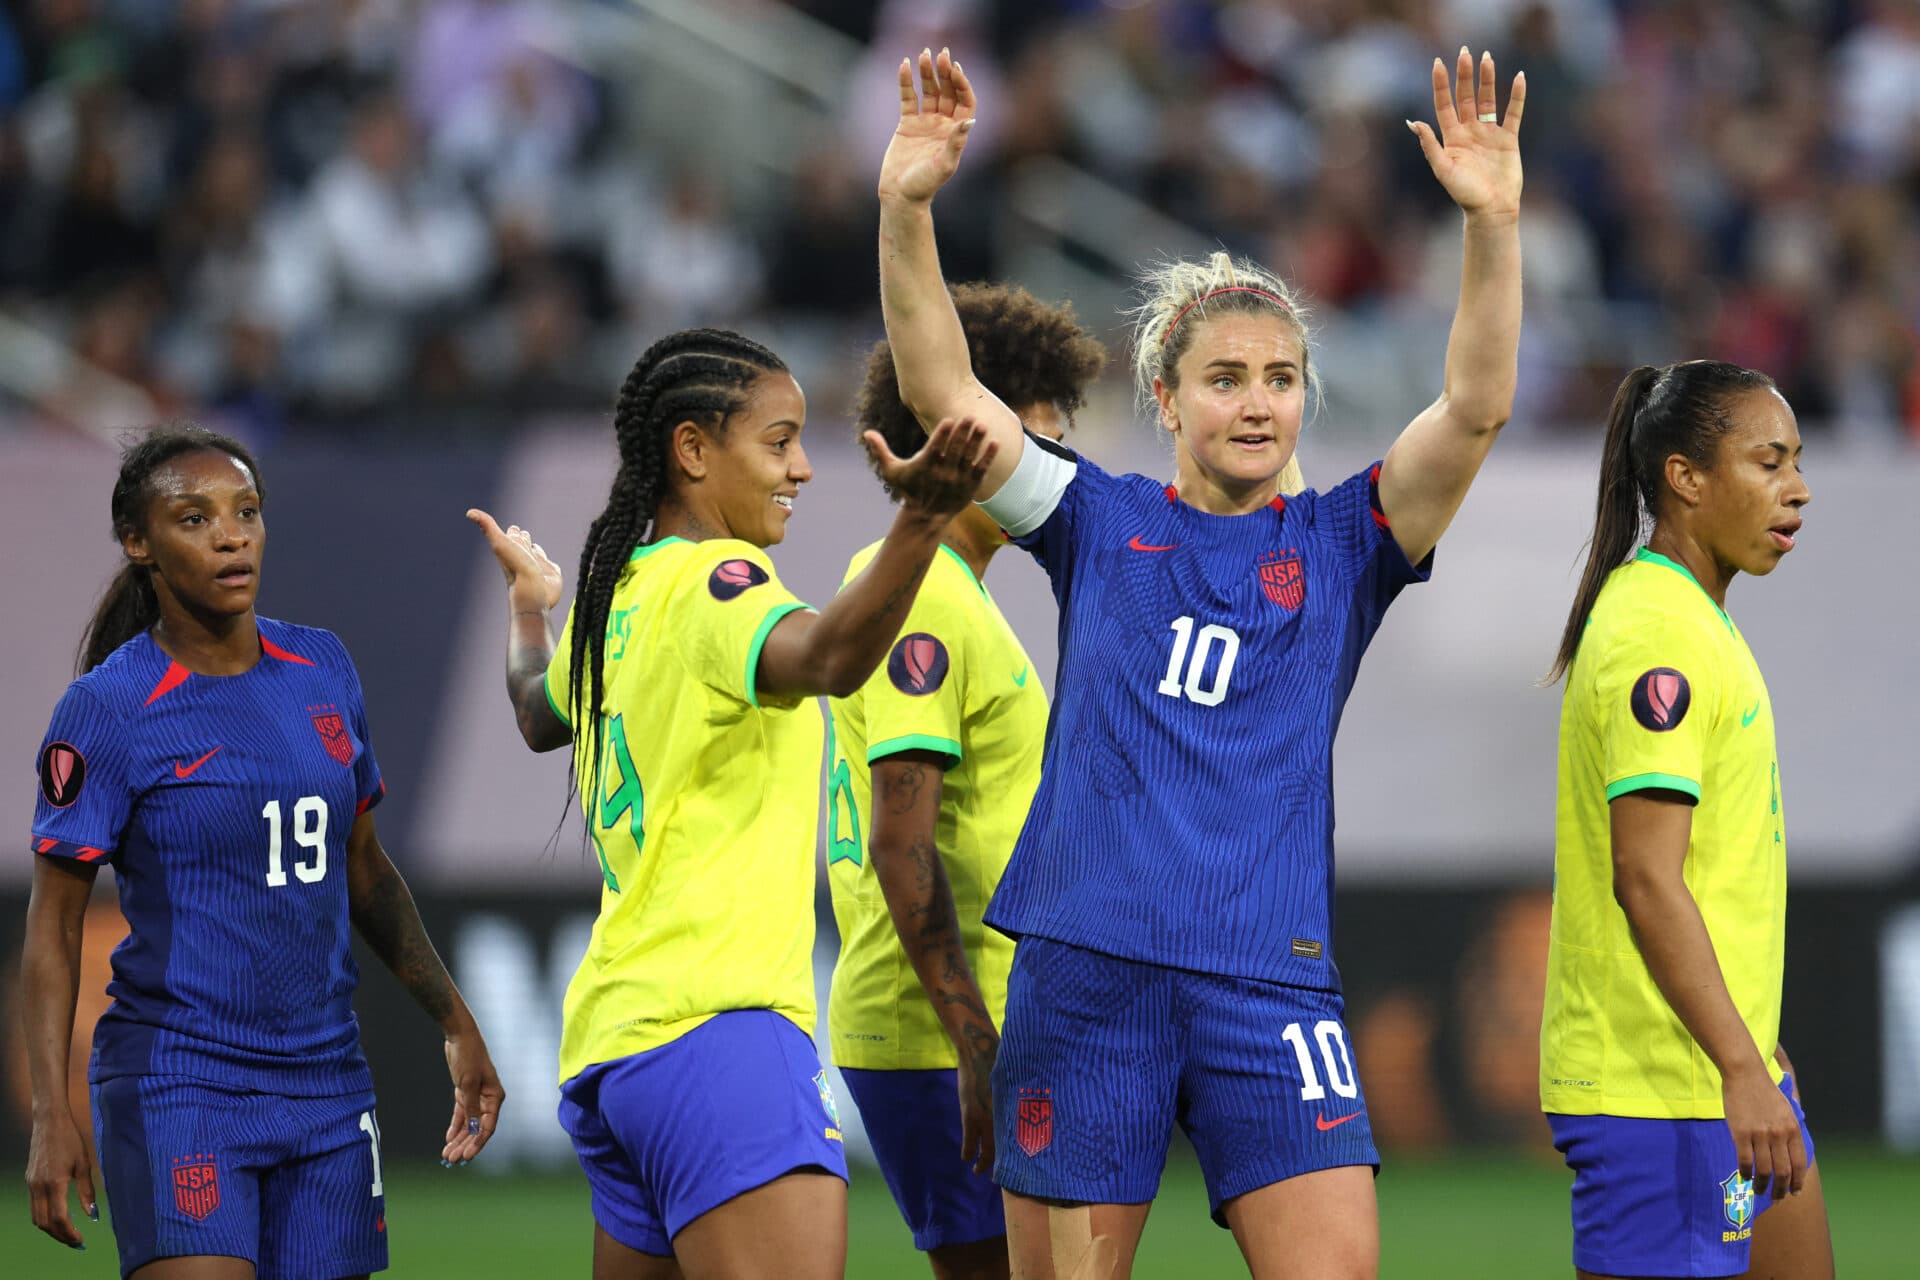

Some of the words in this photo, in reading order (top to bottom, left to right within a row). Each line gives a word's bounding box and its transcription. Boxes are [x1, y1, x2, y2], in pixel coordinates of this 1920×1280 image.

[1261, 561, 1299, 585] USA
[1158, 615, 1240, 707] 10
[314, 717, 341, 736] USA
[262, 795, 328, 887] 19
[1281, 1020, 1357, 1101] 10
[1020, 1101, 1050, 1123] USA
[175, 1167, 214, 1189] USA
[359, 1109, 383, 1198] 1
